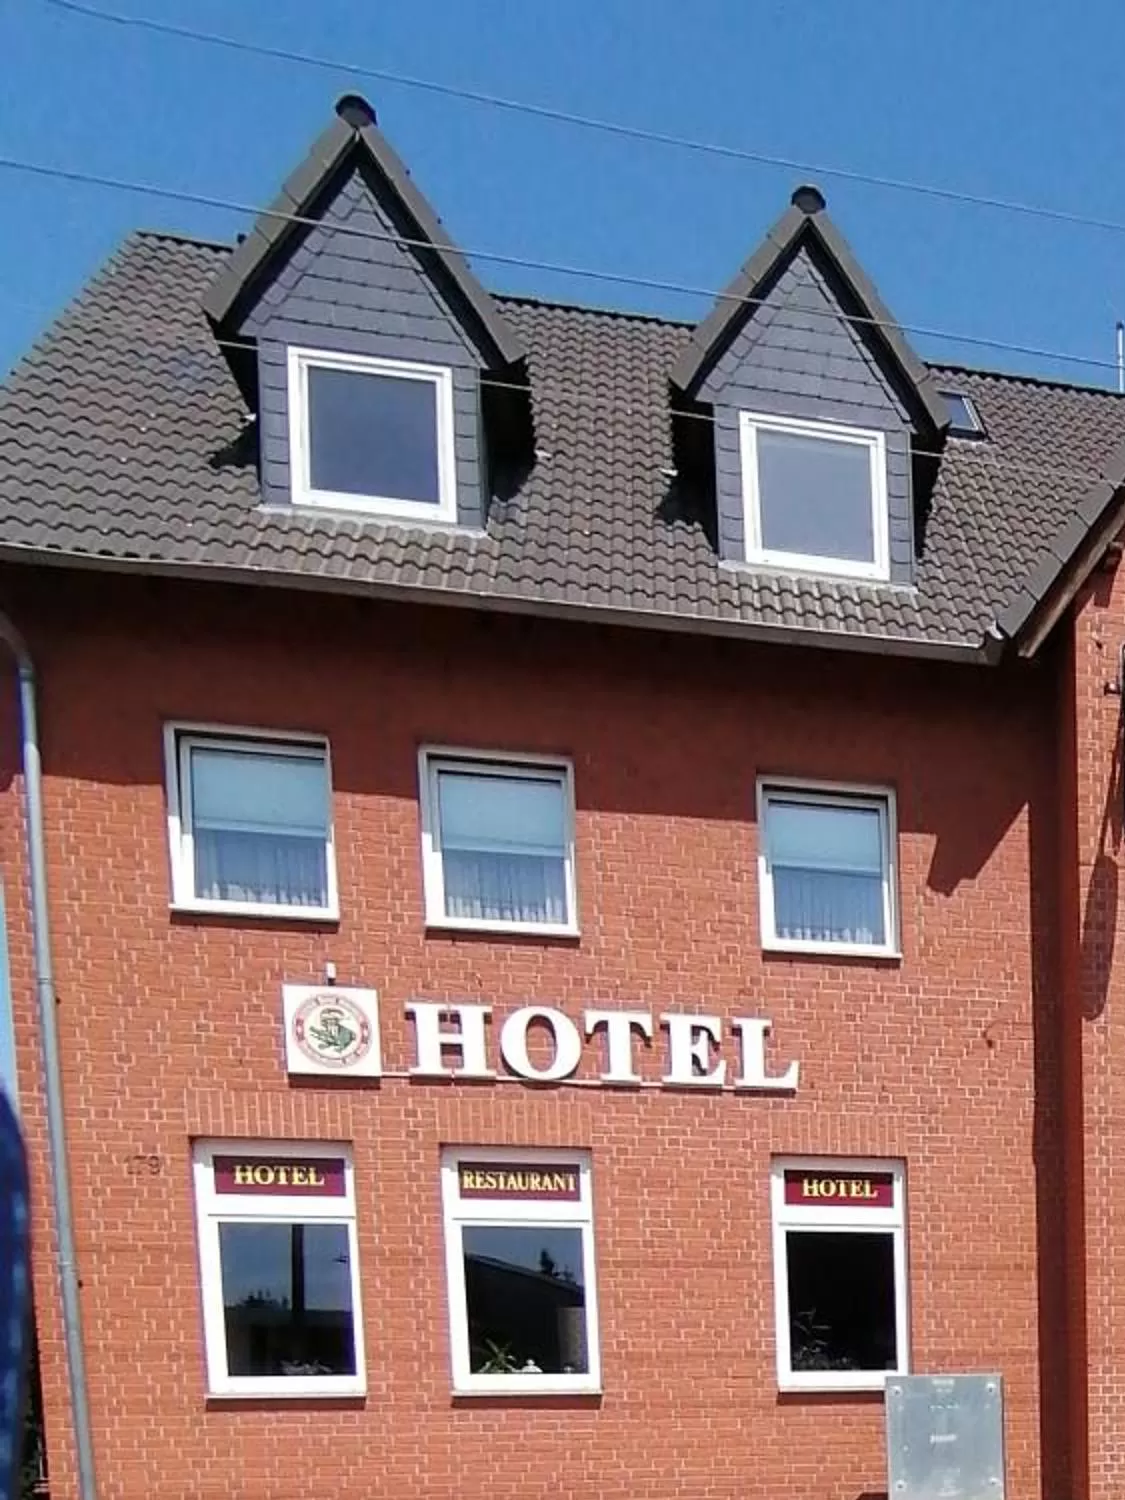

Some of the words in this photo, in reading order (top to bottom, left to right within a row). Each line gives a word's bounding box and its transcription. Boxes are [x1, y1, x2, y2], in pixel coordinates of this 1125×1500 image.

[405, 1001, 799, 1090] HOTEL
[233, 1164, 325, 1188] HOTEL
[462, 1171, 577, 1193] RESTAURANT
[801, 1178, 879, 1200] HOTEL
